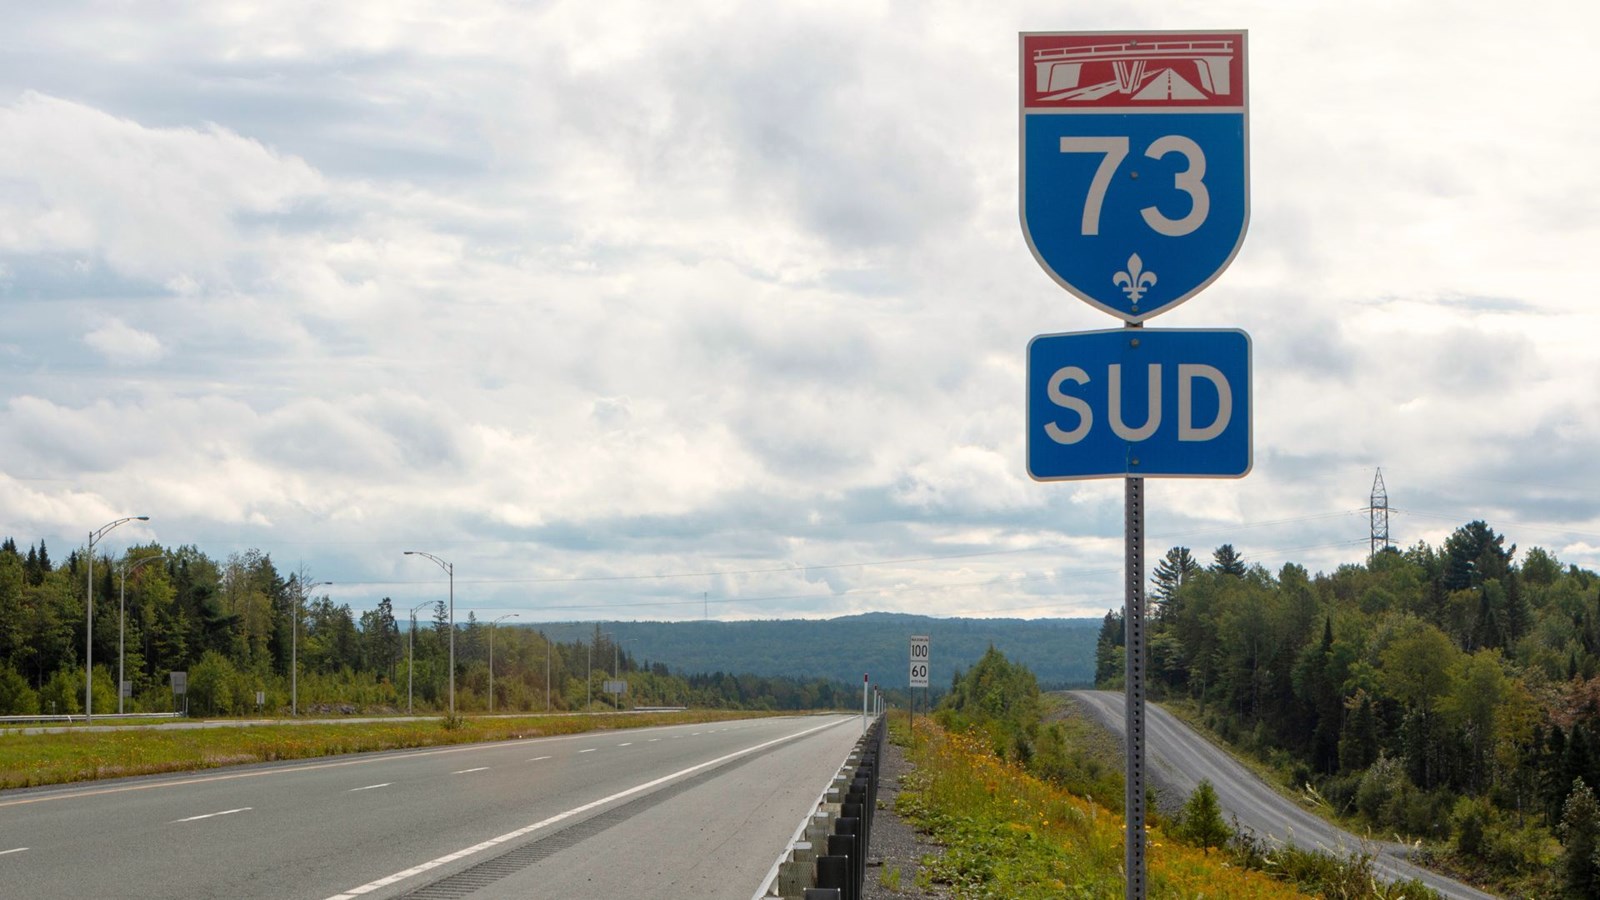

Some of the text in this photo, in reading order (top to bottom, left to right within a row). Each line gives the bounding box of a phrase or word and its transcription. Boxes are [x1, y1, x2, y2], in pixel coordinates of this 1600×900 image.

[1060, 135, 1210, 237] 73
[1043, 363, 1233, 445] SUD
[911, 644, 928, 657] 100
[911, 665, 927, 677] 60
